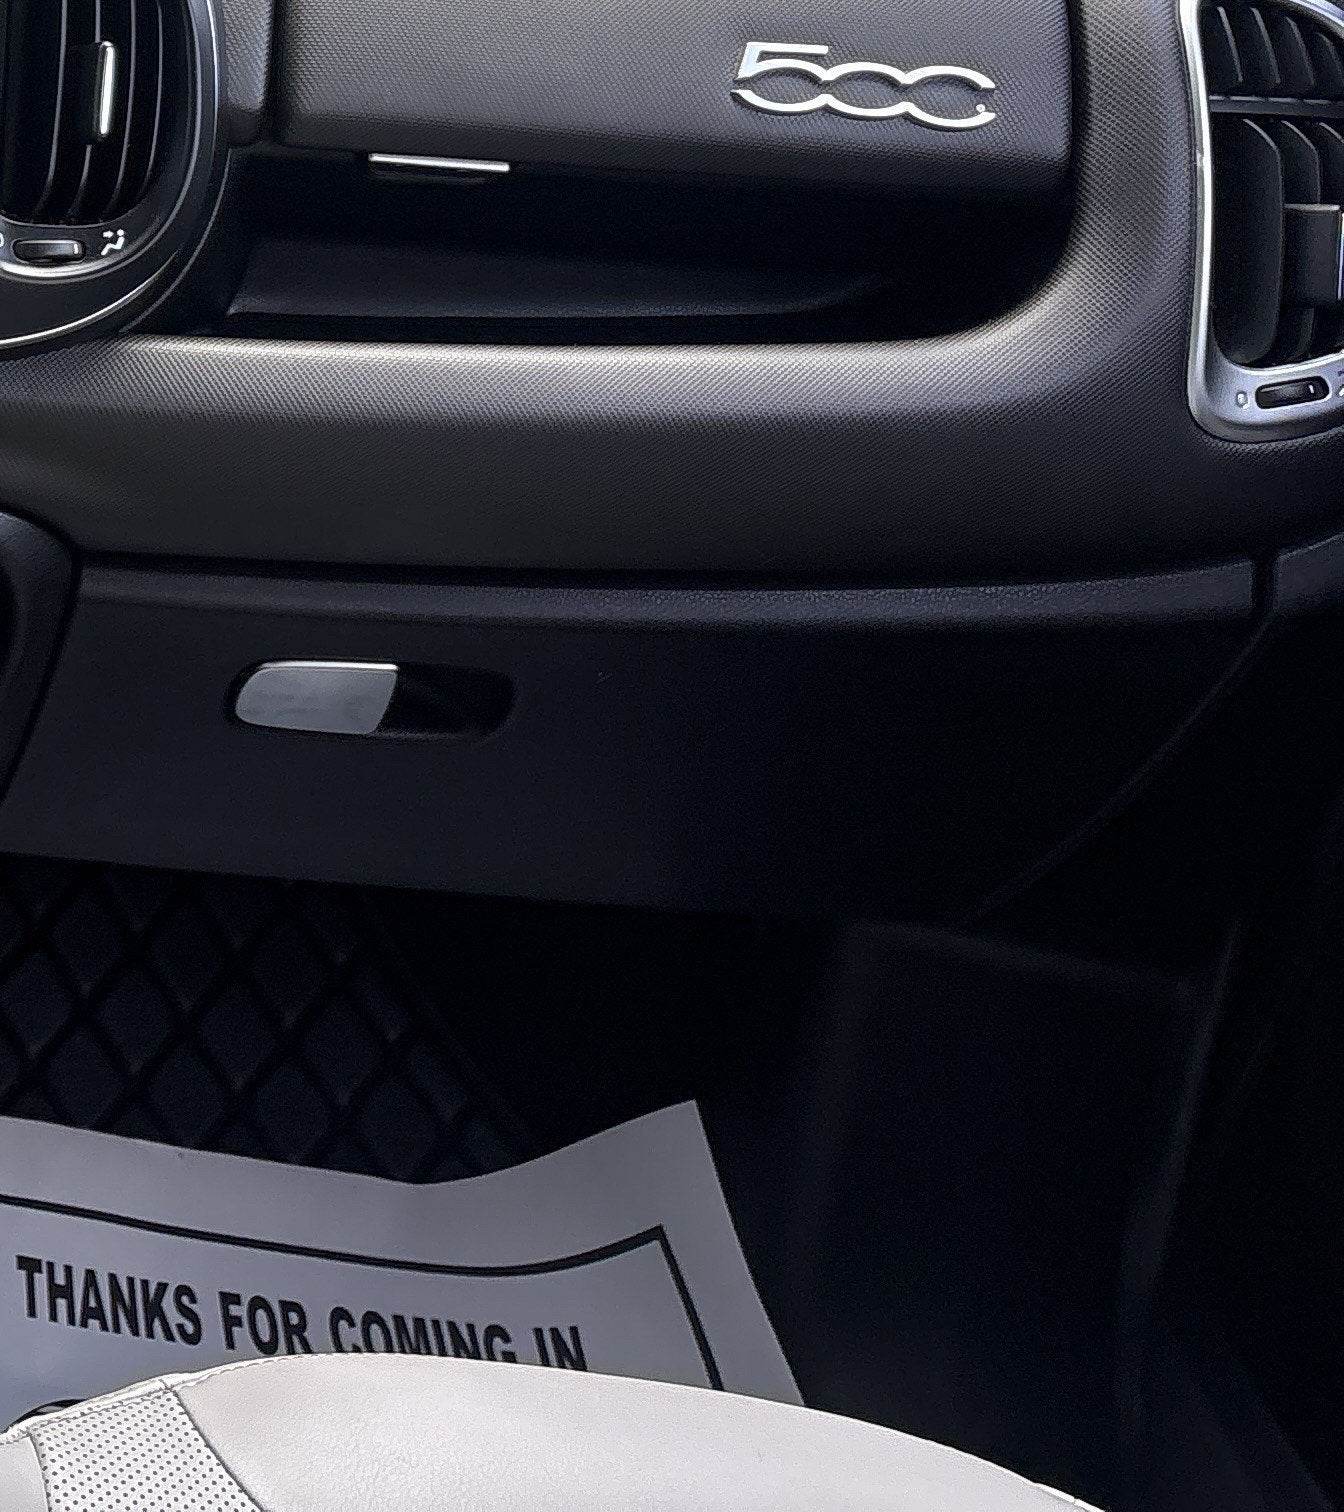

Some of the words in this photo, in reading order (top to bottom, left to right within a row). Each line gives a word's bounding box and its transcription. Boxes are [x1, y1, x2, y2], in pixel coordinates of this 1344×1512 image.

[15, 1254, 203, 1347] THANKS
[218, 1291, 313, 1357] FOR
[327, 1305, 518, 1365] COMING
[531, 1324, 590, 1372] IN
